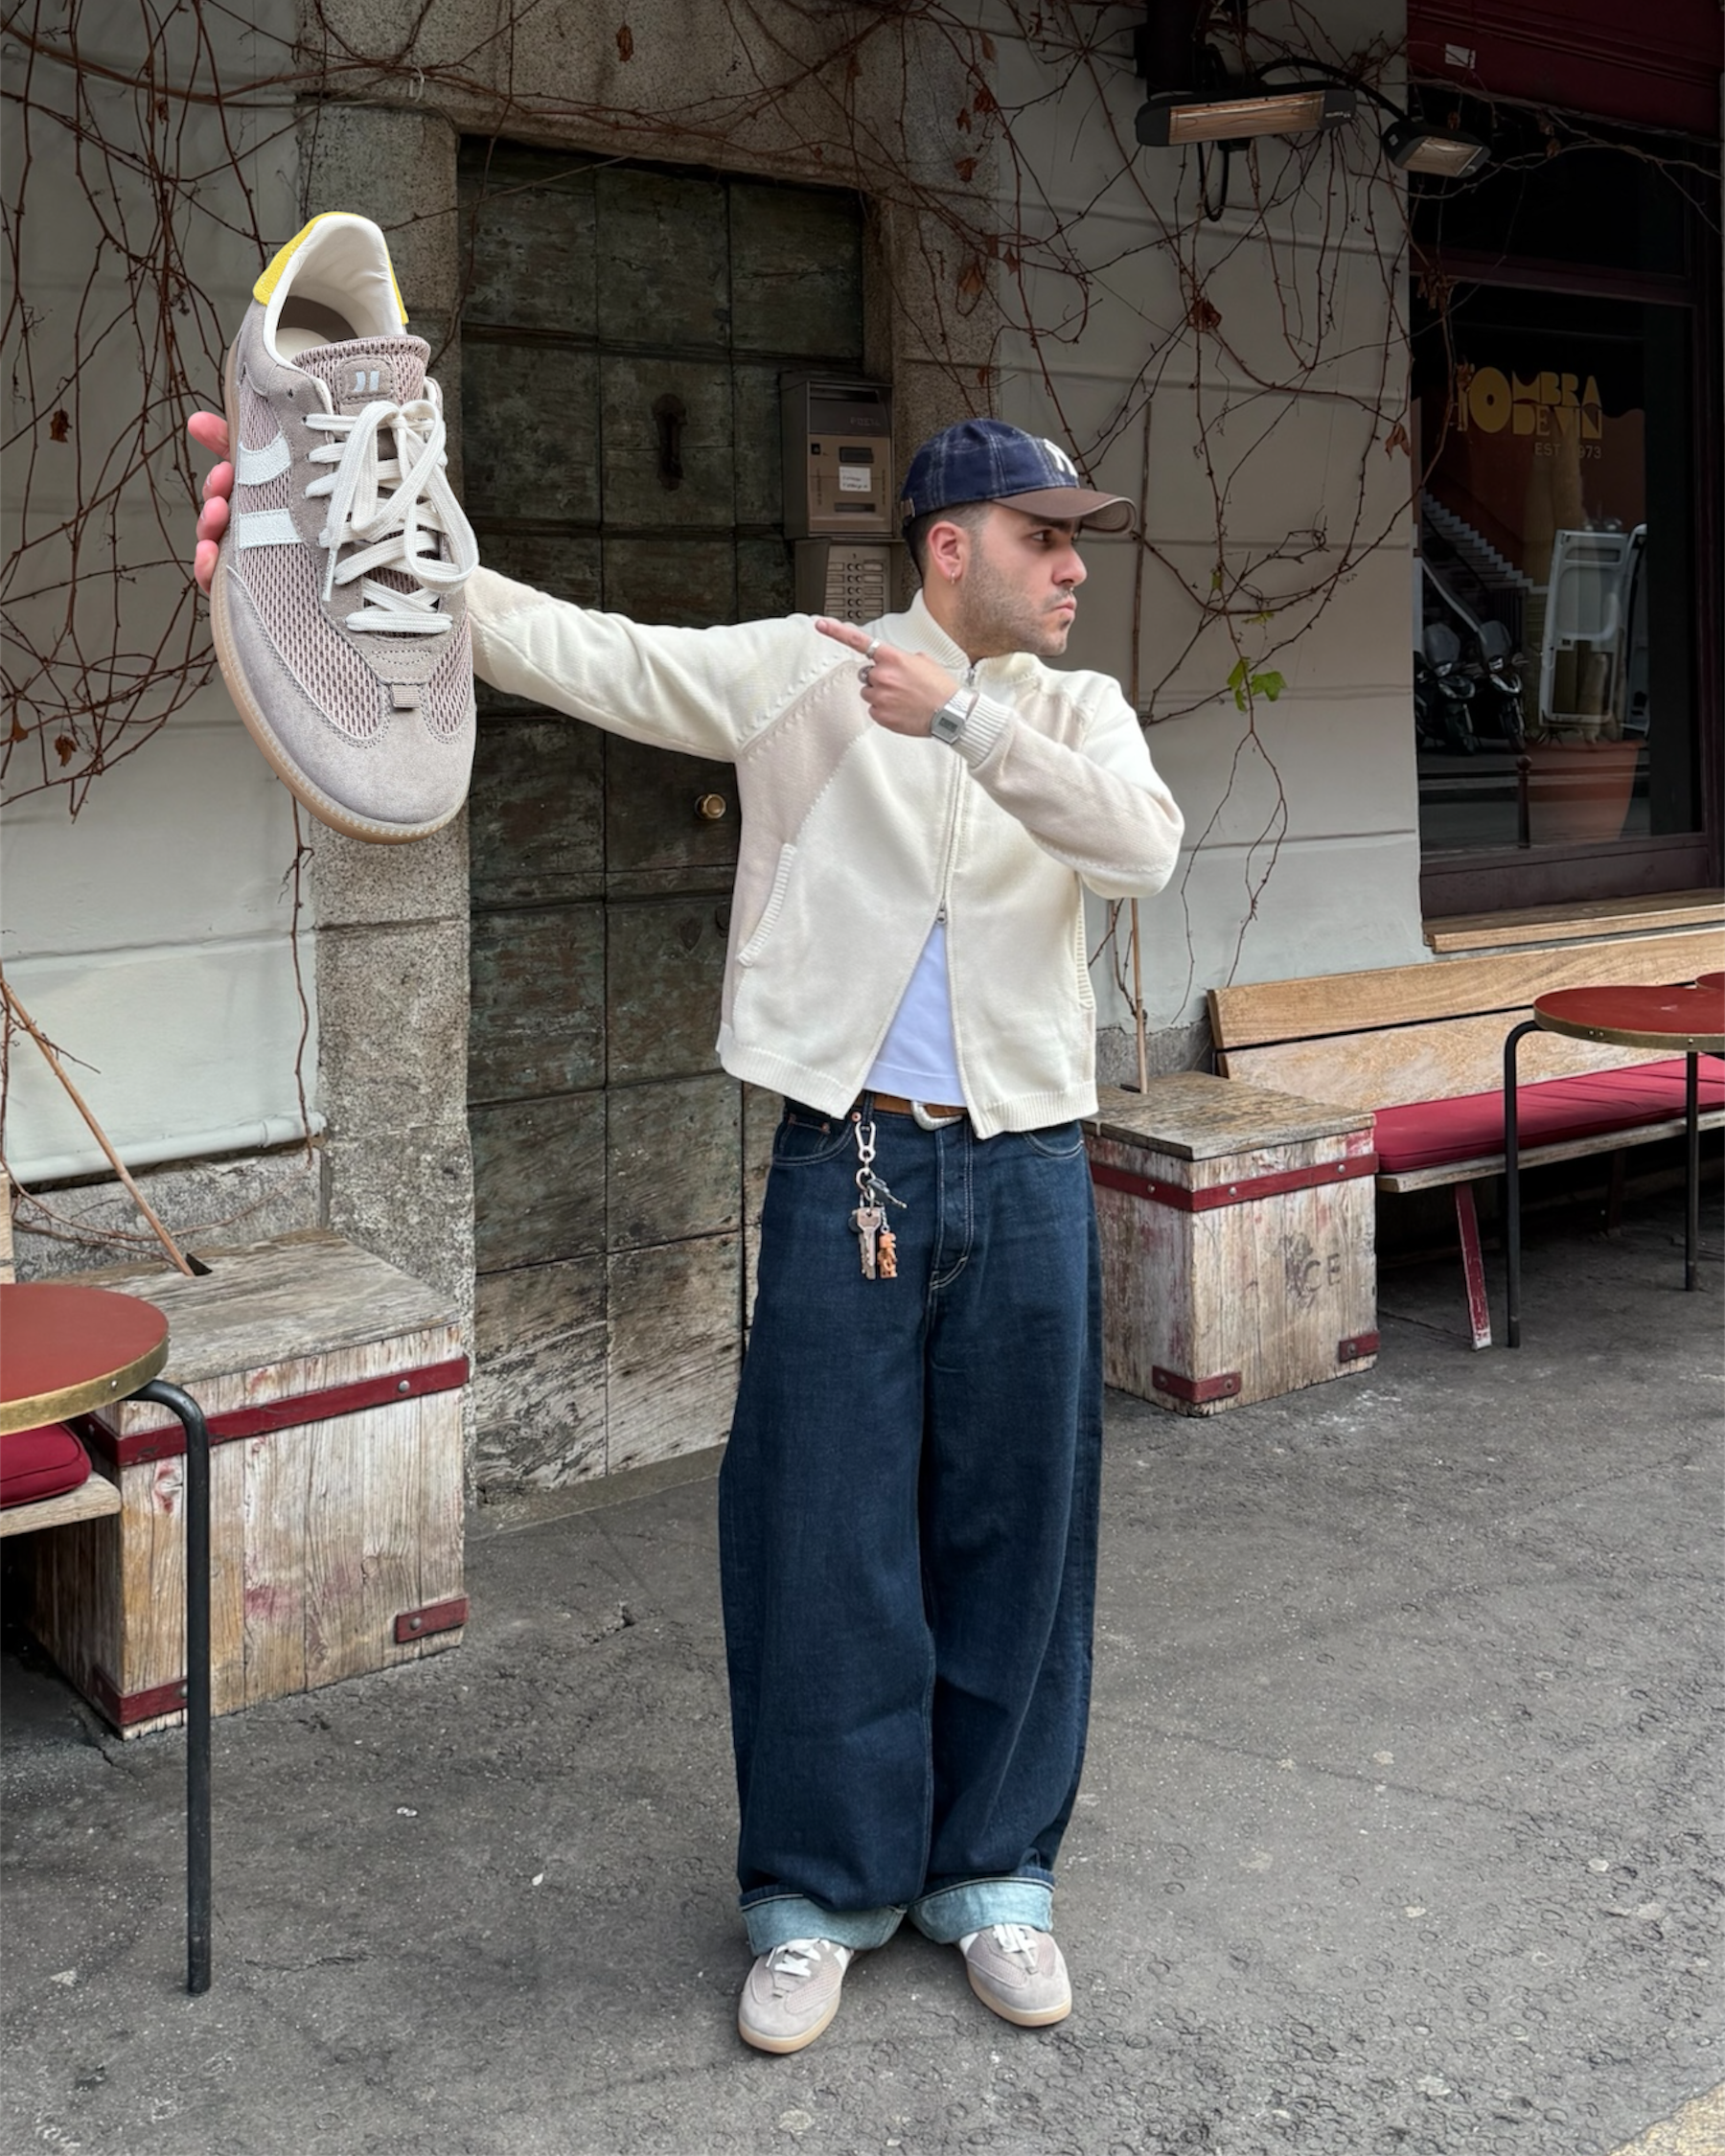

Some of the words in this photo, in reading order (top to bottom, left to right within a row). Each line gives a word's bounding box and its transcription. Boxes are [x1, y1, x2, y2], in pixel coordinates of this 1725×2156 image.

[1512, 402, 1551, 436] DE
[1553, 405, 1602, 439] VIN
[1534, 442, 1560, 457] EST
[1575, 445, 1601, 459] 973
